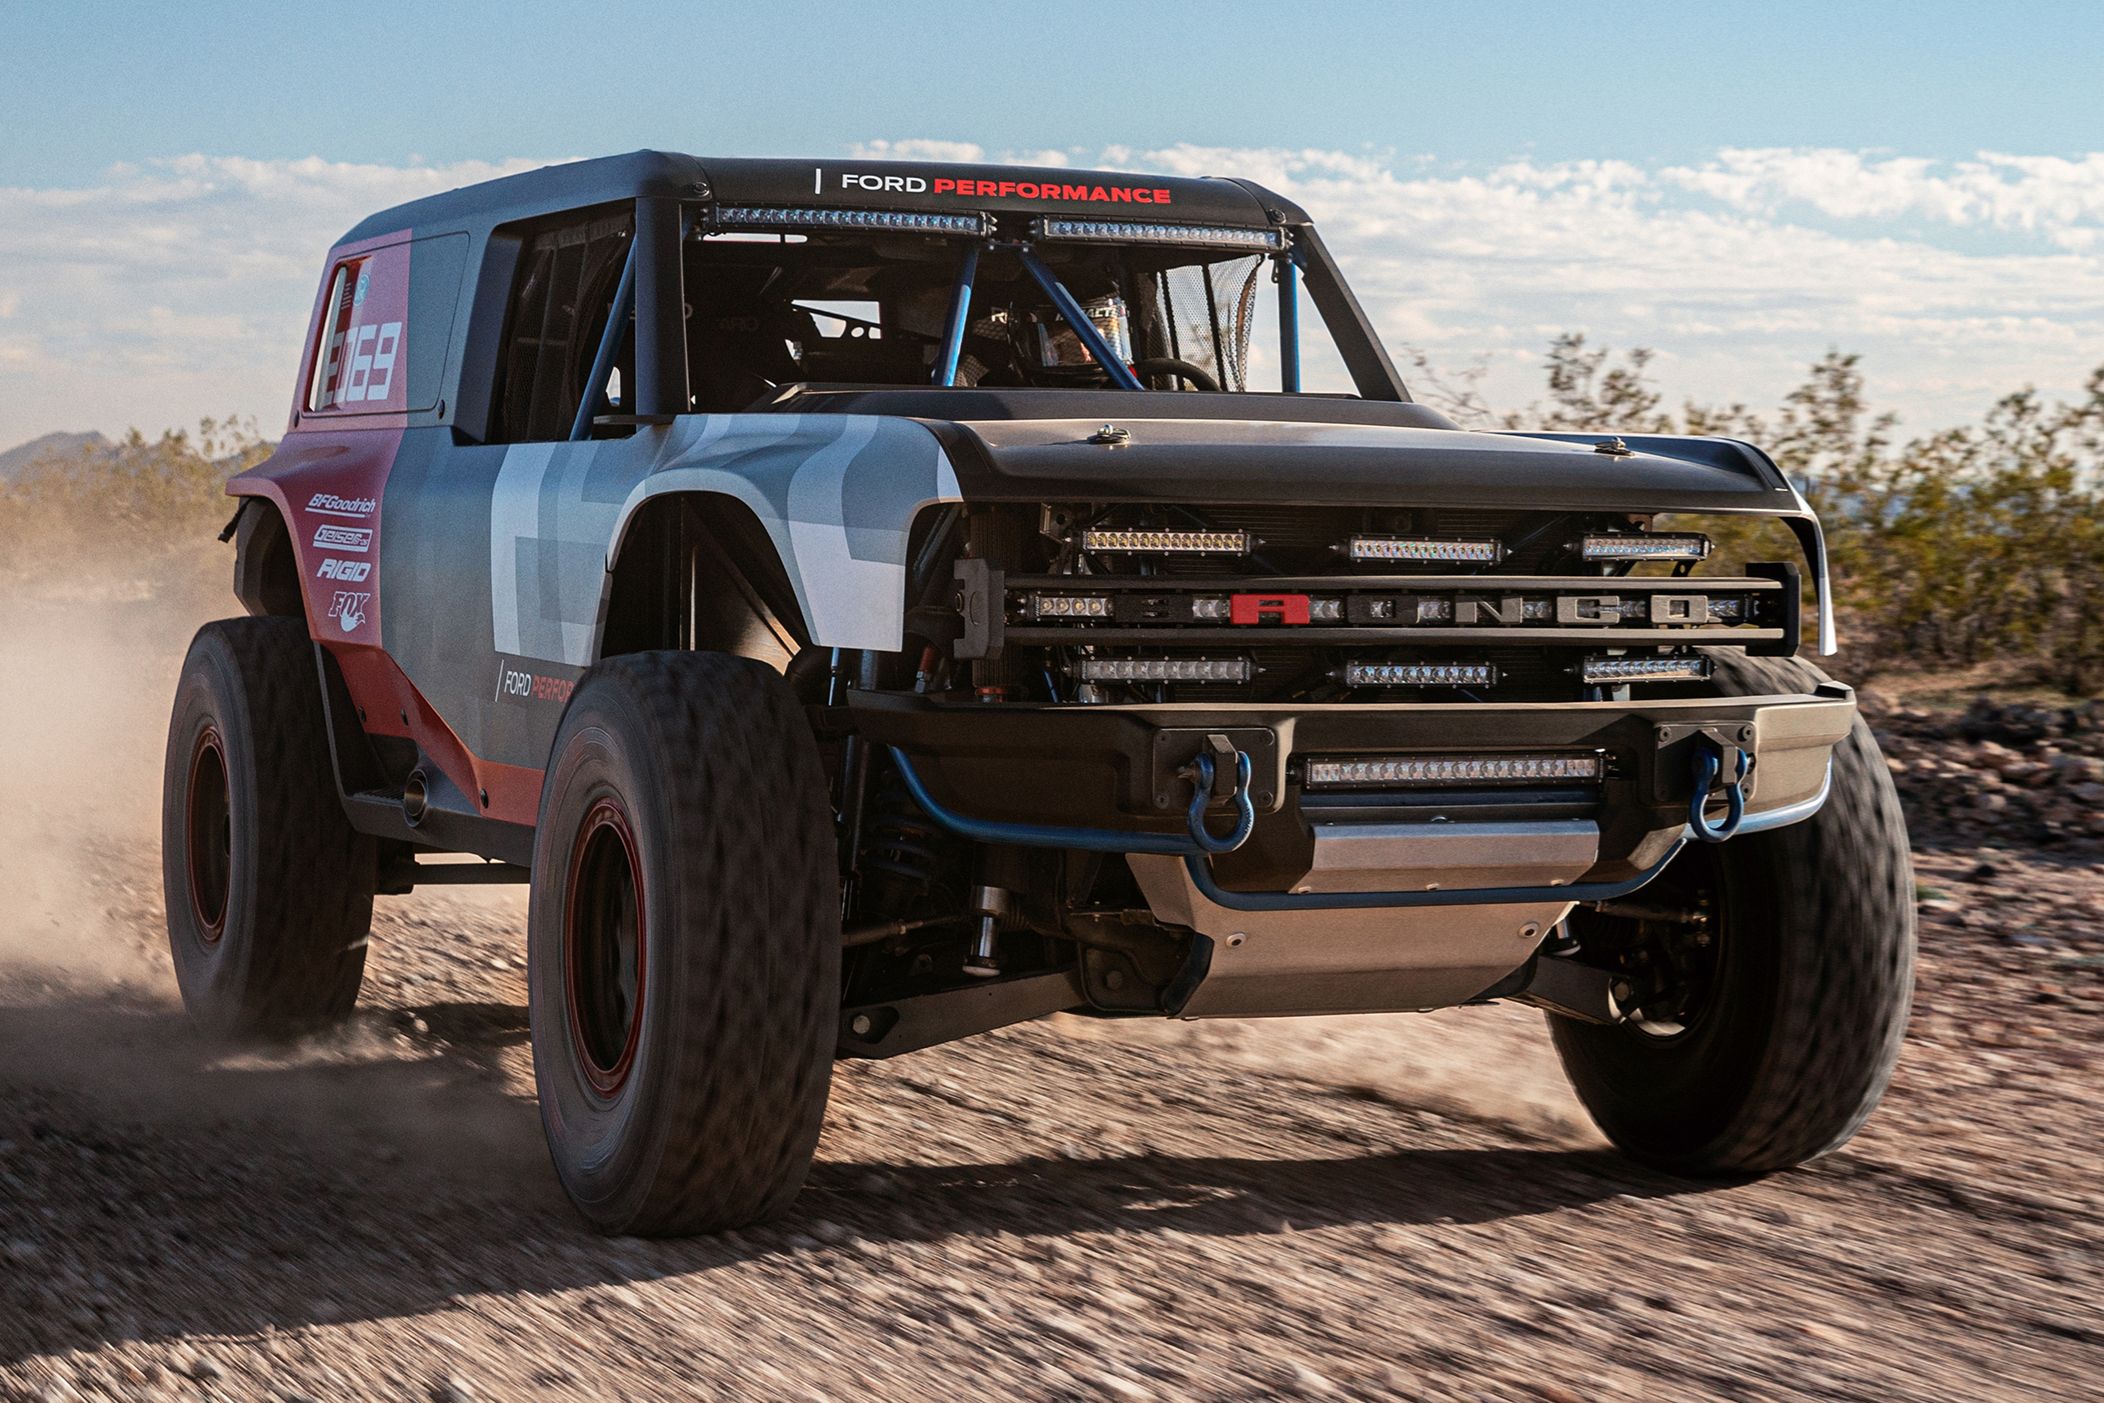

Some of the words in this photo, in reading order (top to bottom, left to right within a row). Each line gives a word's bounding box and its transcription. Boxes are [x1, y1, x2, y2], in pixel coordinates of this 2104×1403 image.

[841, 173, 926, 194] FORD
[934, 177, 1171, 204] PERFORMANCE
[308, 493, 376, 513] BFGoodrich
[317, 558, 371, 582] RIGID
[328, 591, 371, 620] FOX
[504, 670, 532, 697] FORD
